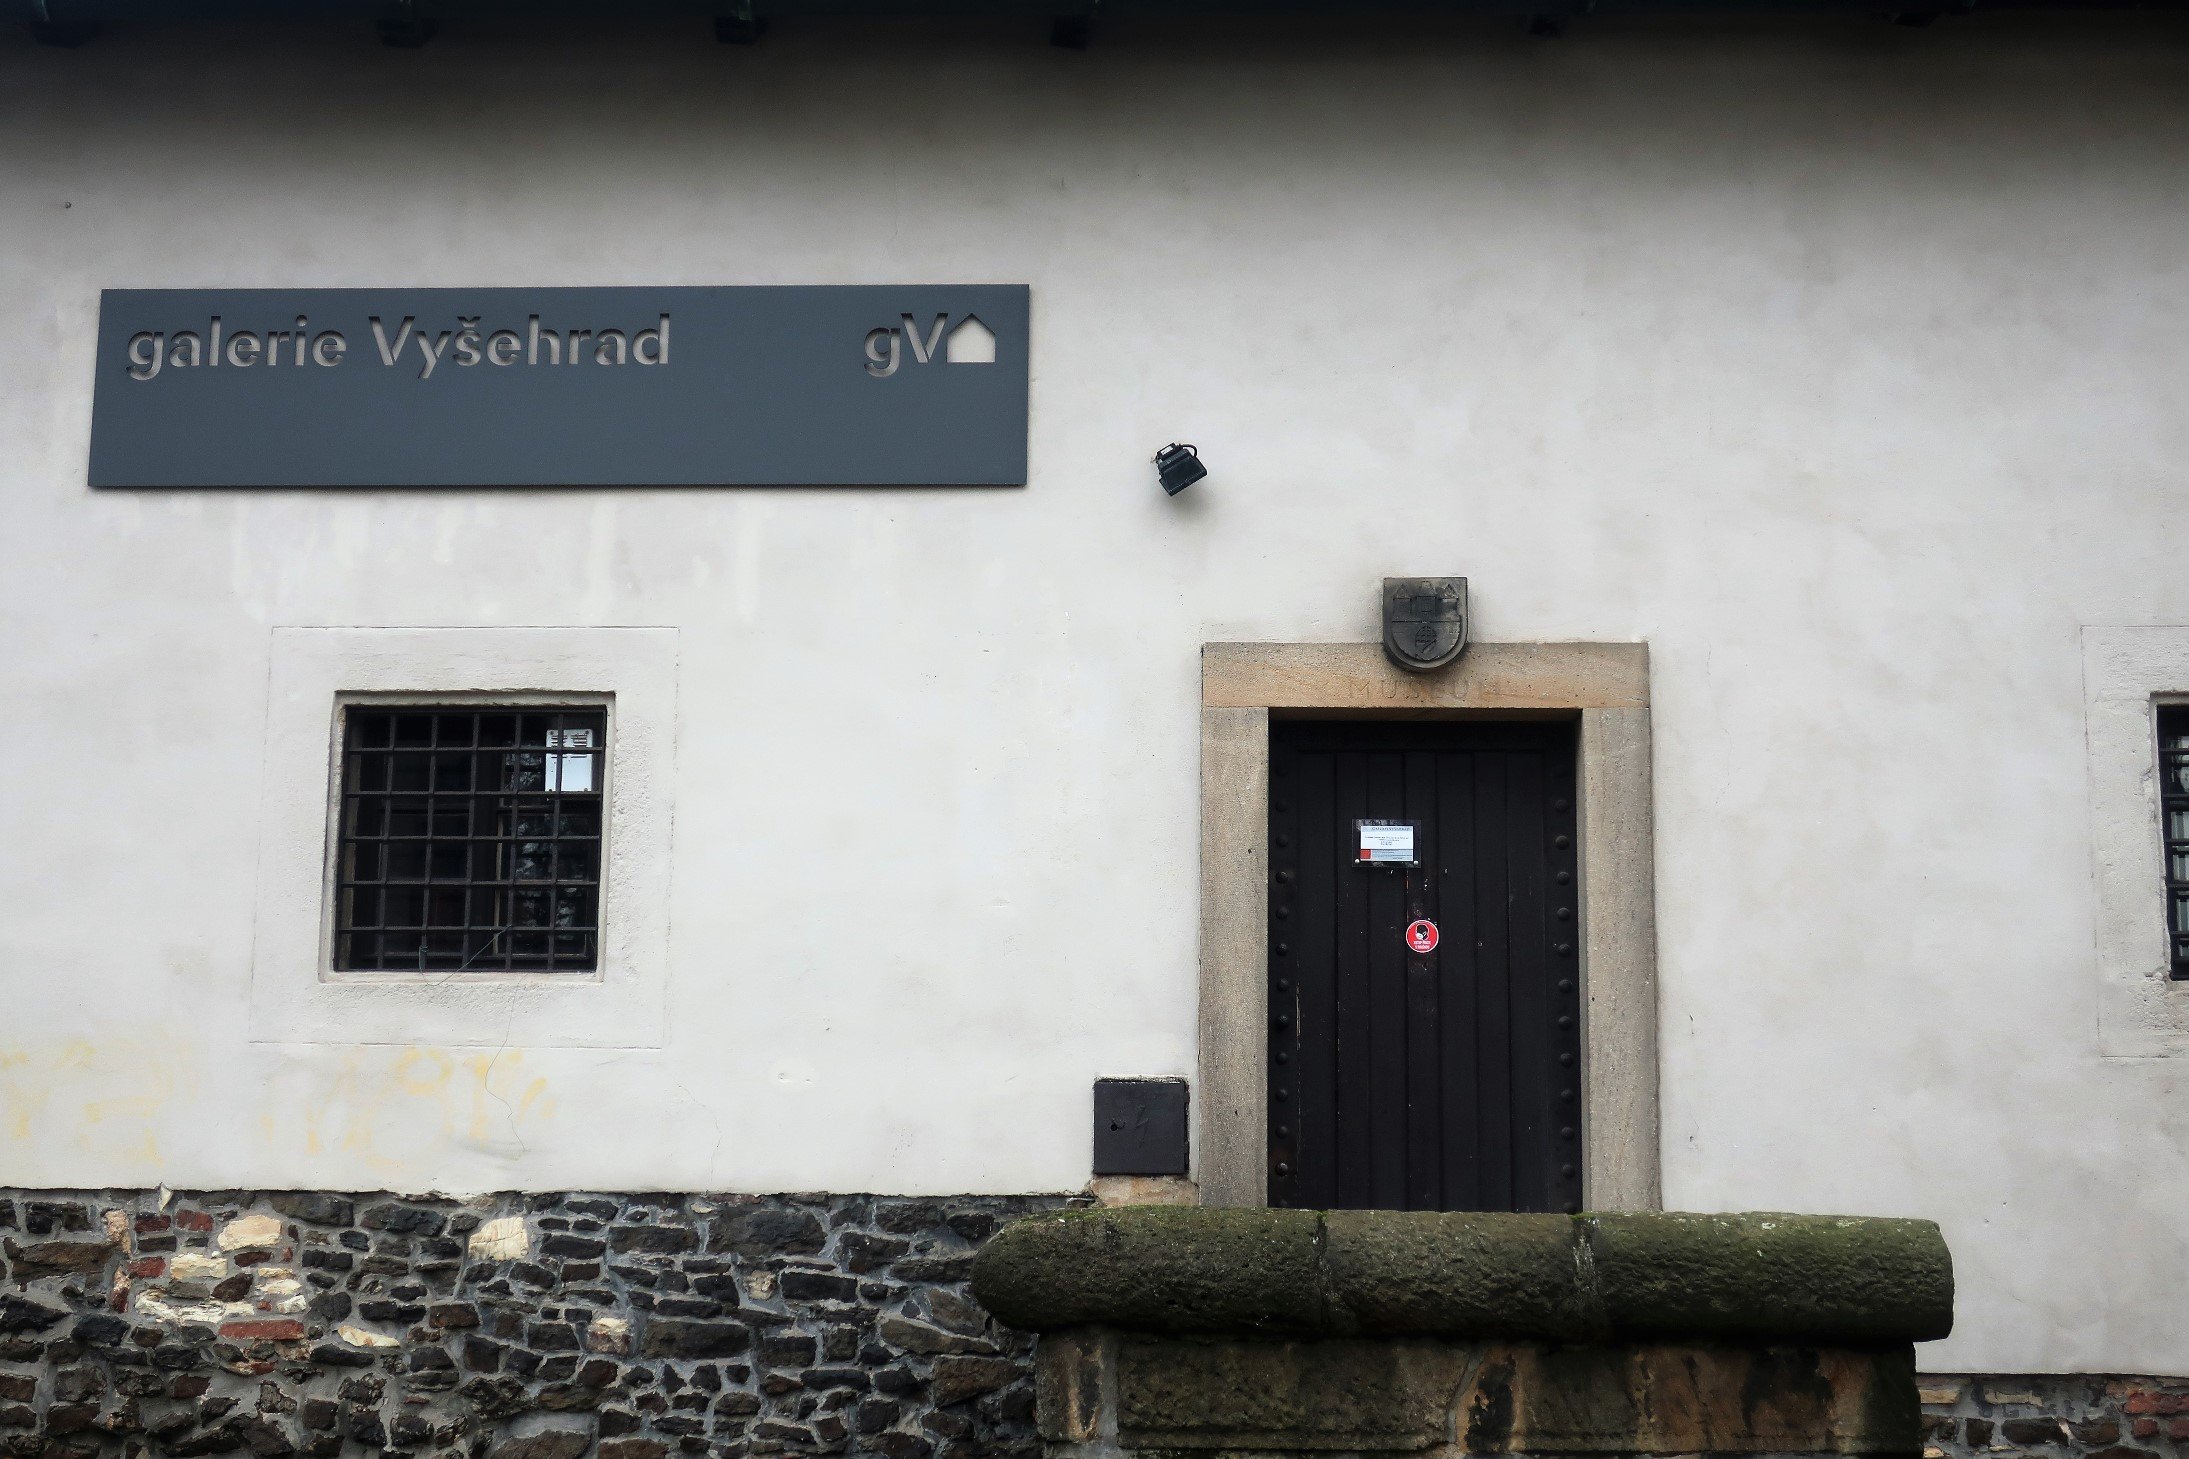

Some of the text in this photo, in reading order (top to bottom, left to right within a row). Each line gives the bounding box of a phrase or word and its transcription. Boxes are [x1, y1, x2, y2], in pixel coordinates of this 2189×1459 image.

[126, 312, 670, 381] galerie Vyšehrad
[863, 312, 949, 378] gV
